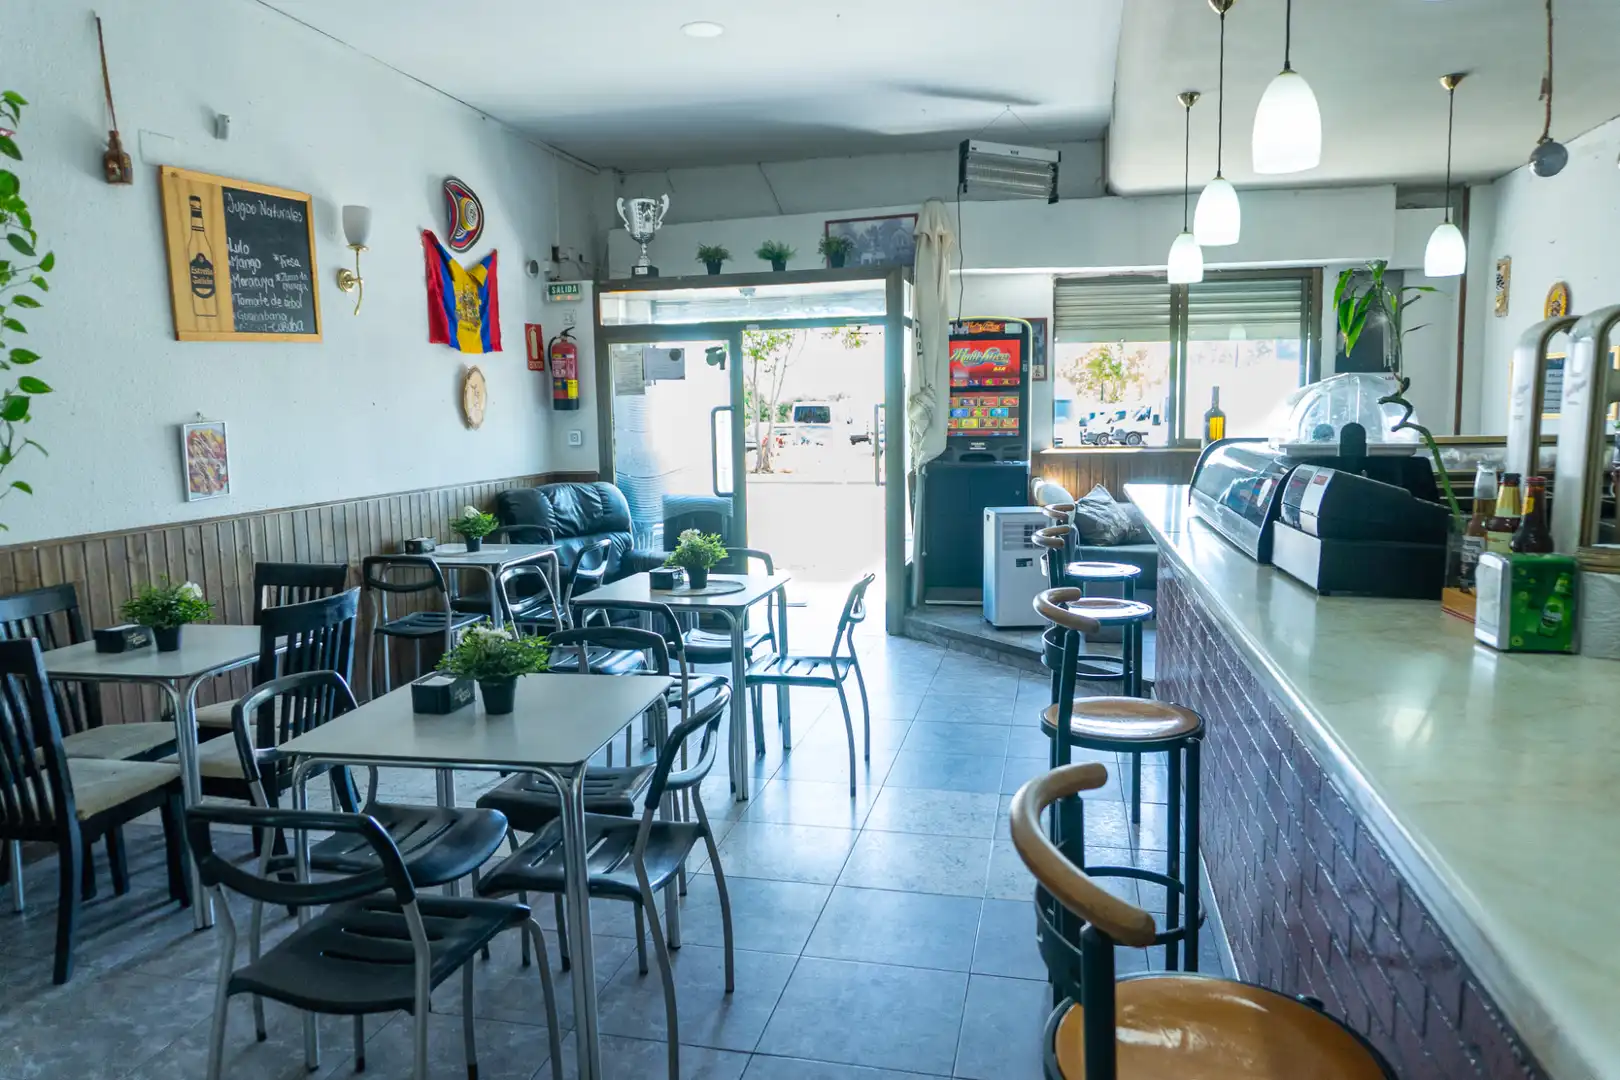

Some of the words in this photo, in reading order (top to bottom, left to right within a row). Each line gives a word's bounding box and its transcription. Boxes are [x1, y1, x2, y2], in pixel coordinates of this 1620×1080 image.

[228, 237, 250, 255] Lulo
[230, 255, 262, 275] Mango
[551, 284, 577, 295] SALIDA
[233, 291, 270, 307] Tomate
[270, 293, 283, 308] de
